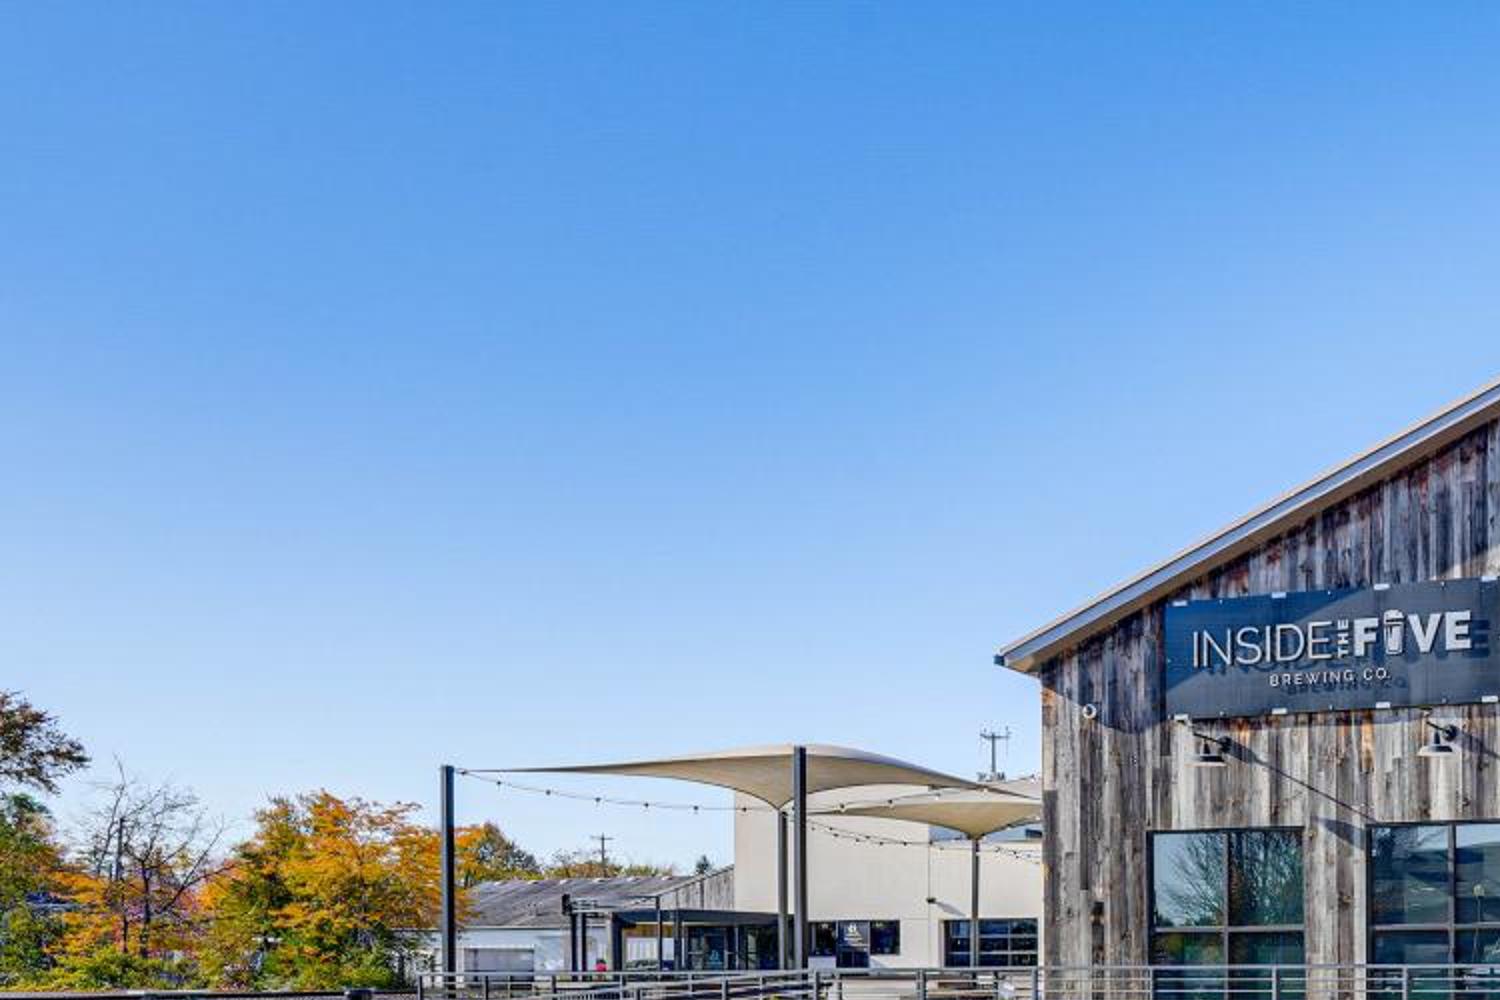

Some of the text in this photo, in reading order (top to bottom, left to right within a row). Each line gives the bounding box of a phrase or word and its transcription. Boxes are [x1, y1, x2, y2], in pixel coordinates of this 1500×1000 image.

[1193, 609, 1473, 668] INSIDE THE FIVE
[1269, 667, 1391, 687] BREWING CO.
